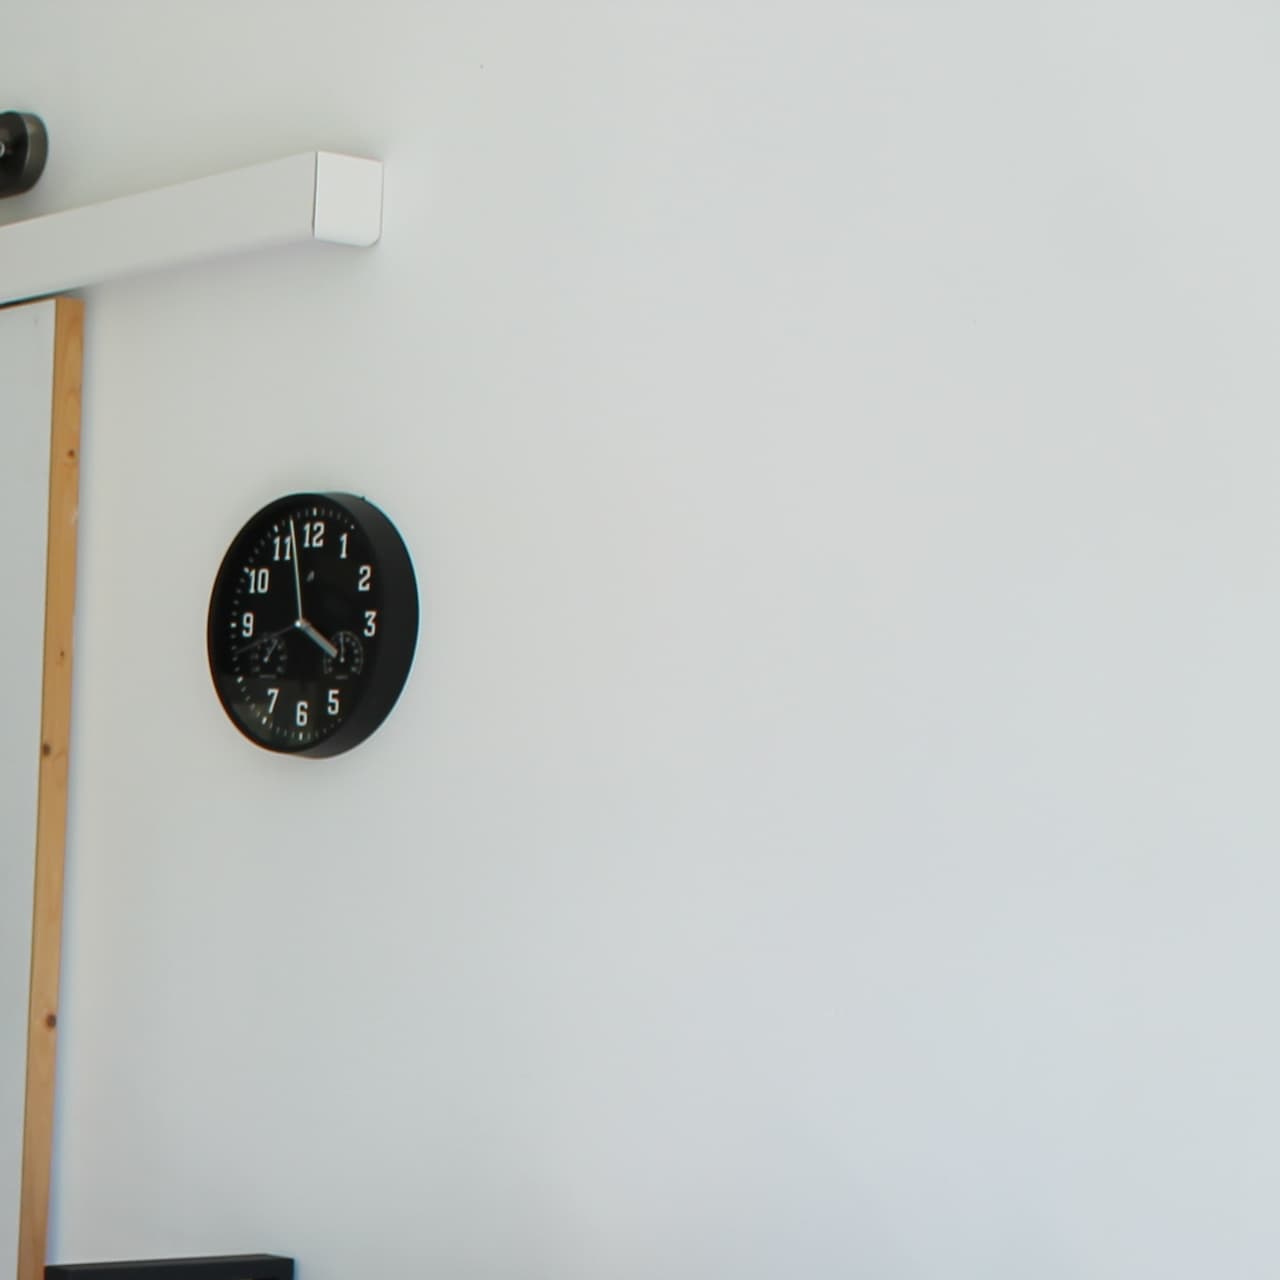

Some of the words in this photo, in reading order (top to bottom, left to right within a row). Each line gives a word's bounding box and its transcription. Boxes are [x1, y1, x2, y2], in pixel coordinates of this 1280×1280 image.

[273, 535, 291, 561] 11
[303, 522, 324, 548] 12
[339, 533, 348, 559] 1
[248, 568, 269, 594] 10
[358, 565, 372, 592] 2
[242, 612, 254, 638] 9
[363, 610, 377, 637] 3
[267, 688, 279, 714] 7
[296, 701, 308, 727] 6
[327, 689, 339, 715] 5
